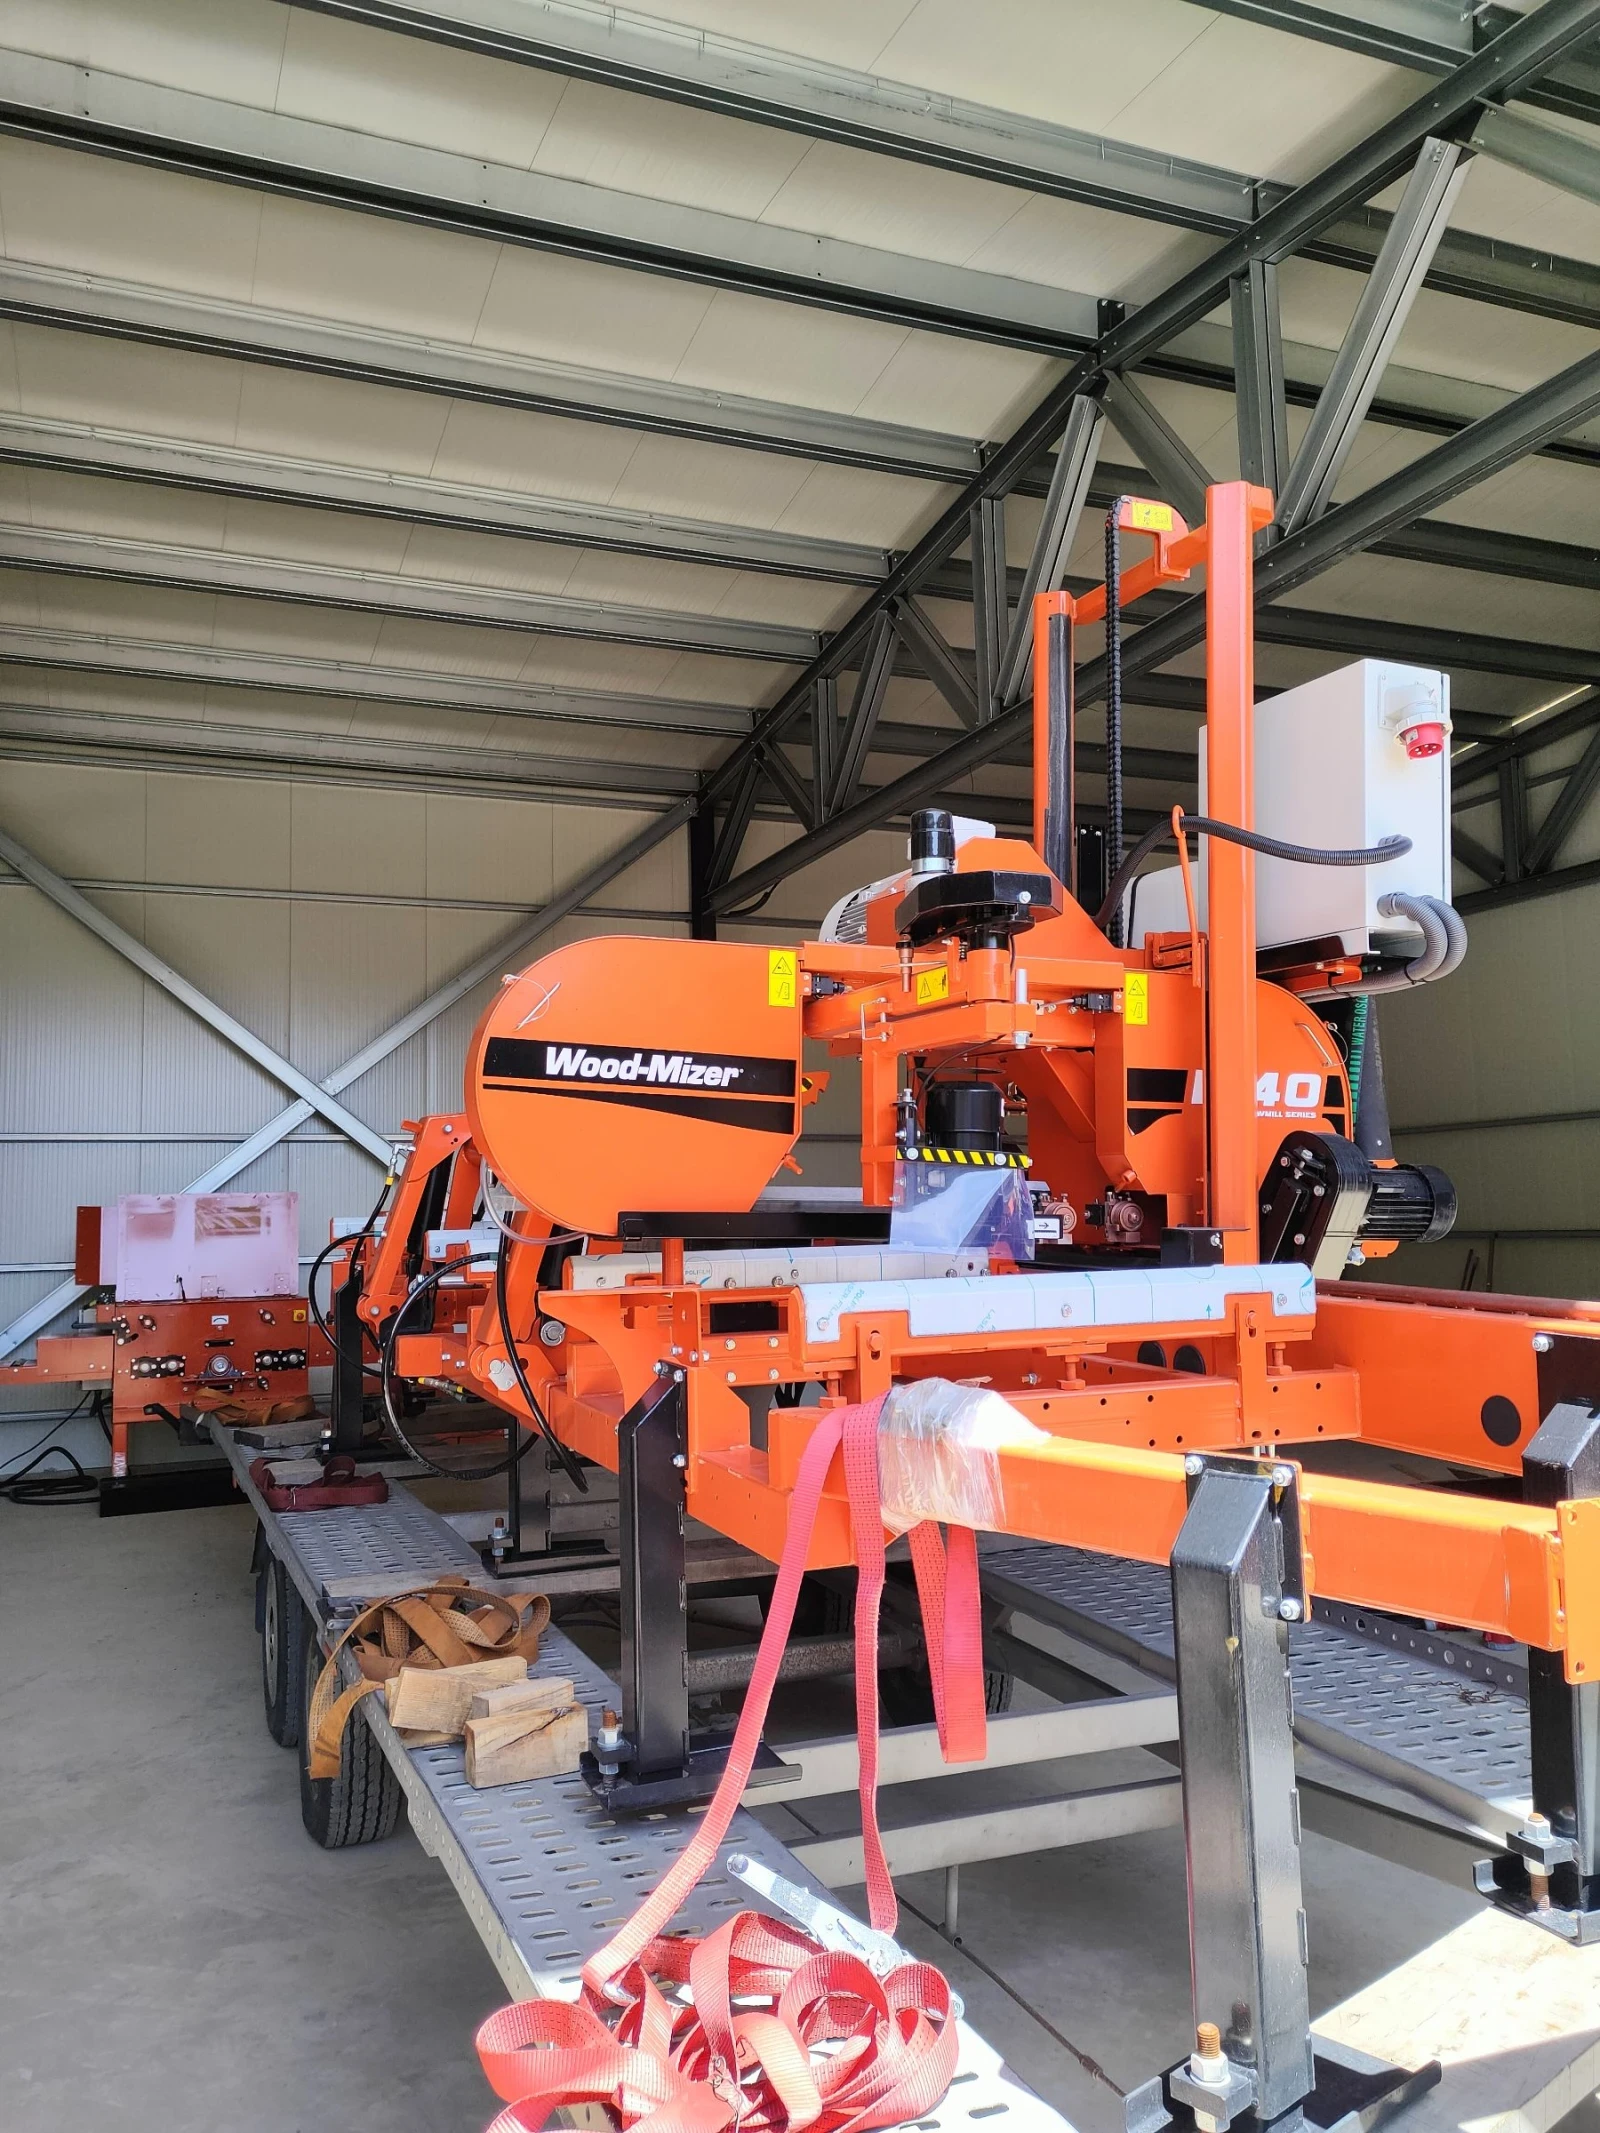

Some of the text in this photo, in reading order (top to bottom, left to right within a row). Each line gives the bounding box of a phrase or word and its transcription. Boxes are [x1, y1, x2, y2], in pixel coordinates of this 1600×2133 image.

[1351, 1016, 1367, 1046] WATER
[545, 1046, 741, 1087] Wood-Mizer
[1284, 1111, 1317, 1119] SERIES
